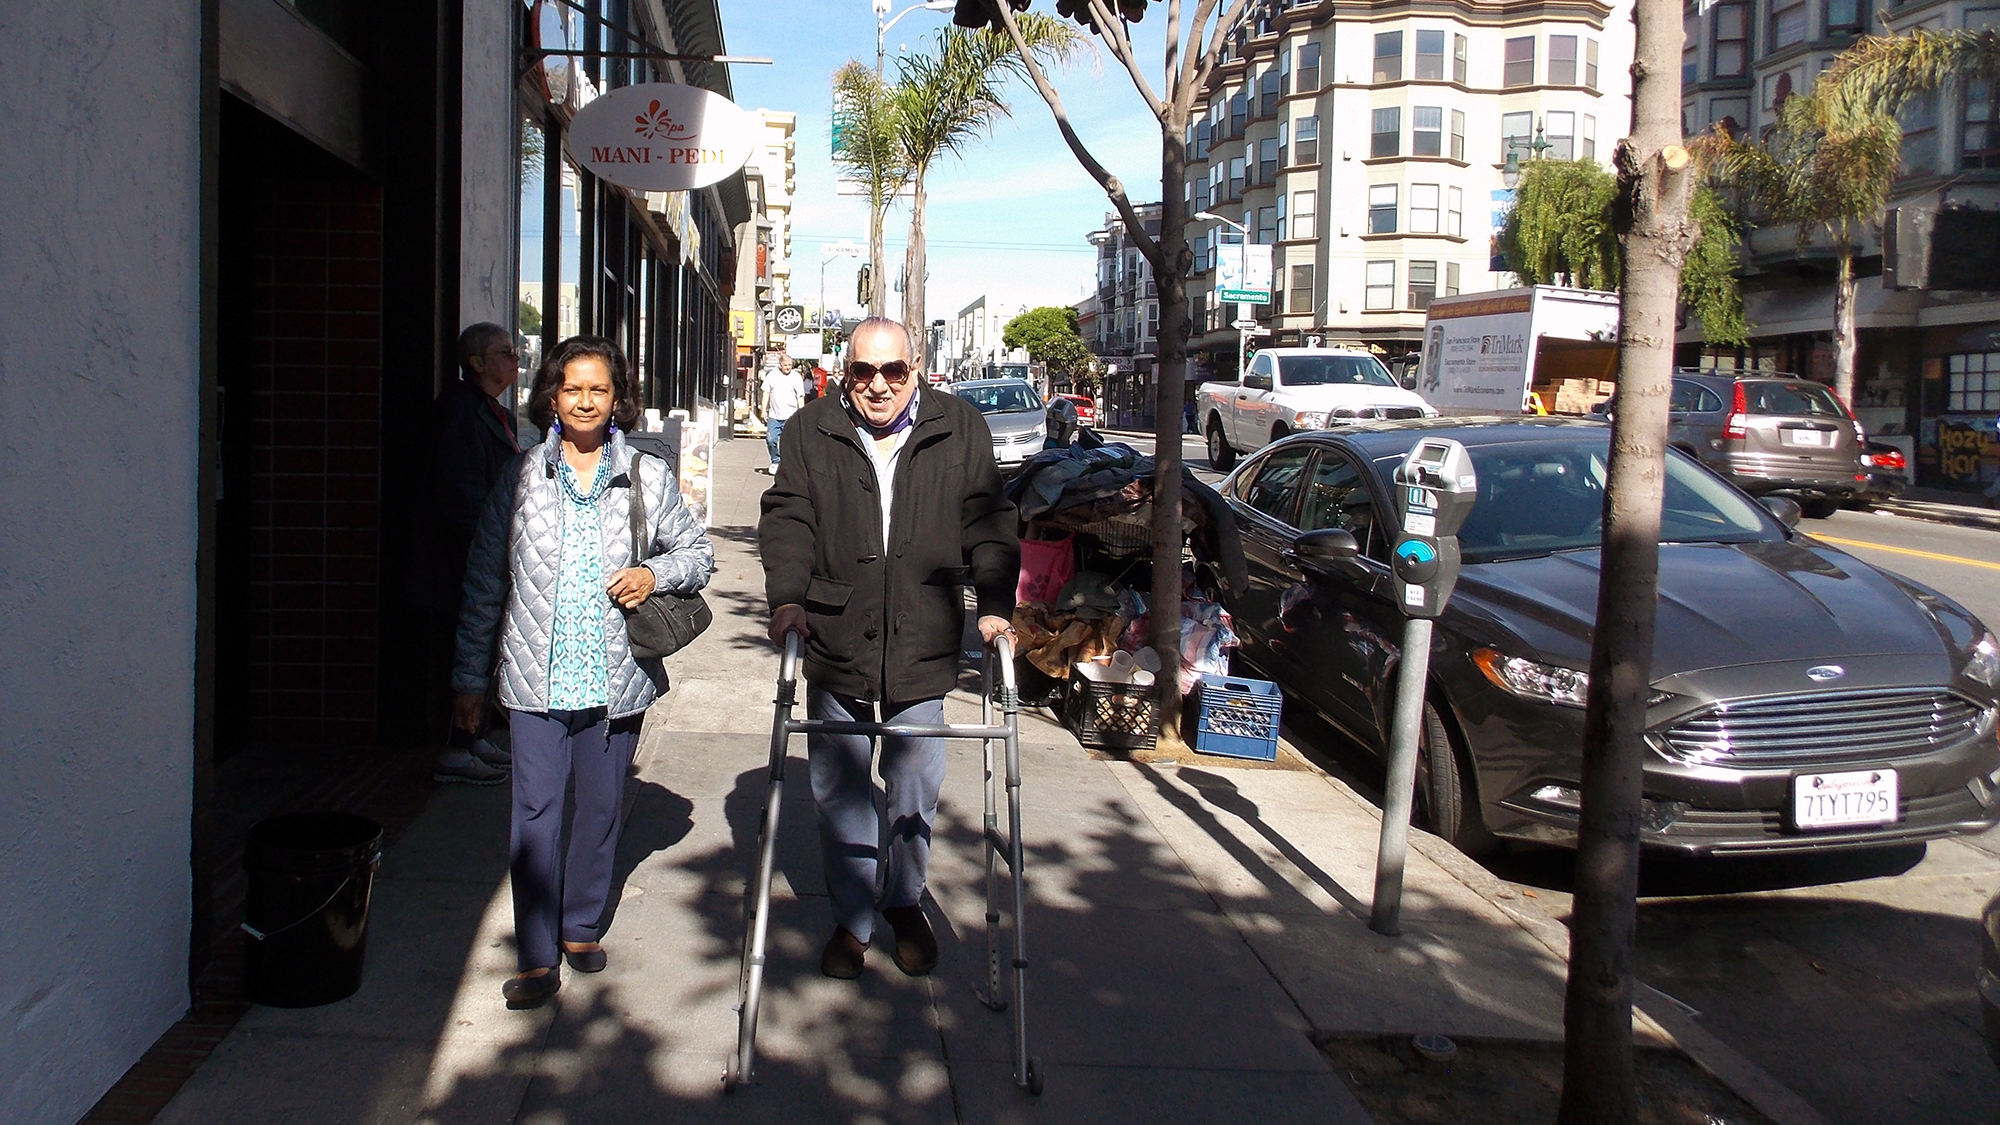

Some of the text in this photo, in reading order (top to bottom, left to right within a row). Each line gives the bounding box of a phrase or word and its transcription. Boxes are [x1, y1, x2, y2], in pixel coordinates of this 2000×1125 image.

[654, 118, 685, 136] Spa
[590, 146, 651, 164] MANI
[668, 147, 725, 165] PEDI
[1222, 291, 1268, 302] Sacramento
[1453, 336, 1470, 344] Francisco
[1470, 335, 1480, 344] Store
[1491, 334, 1524, 354] TriMark
[1444, 358, 1466, 366] Sacramento
[1466, 357, 1476, 365] Store
[1803, 790, 1889, 818] 7TYT795
